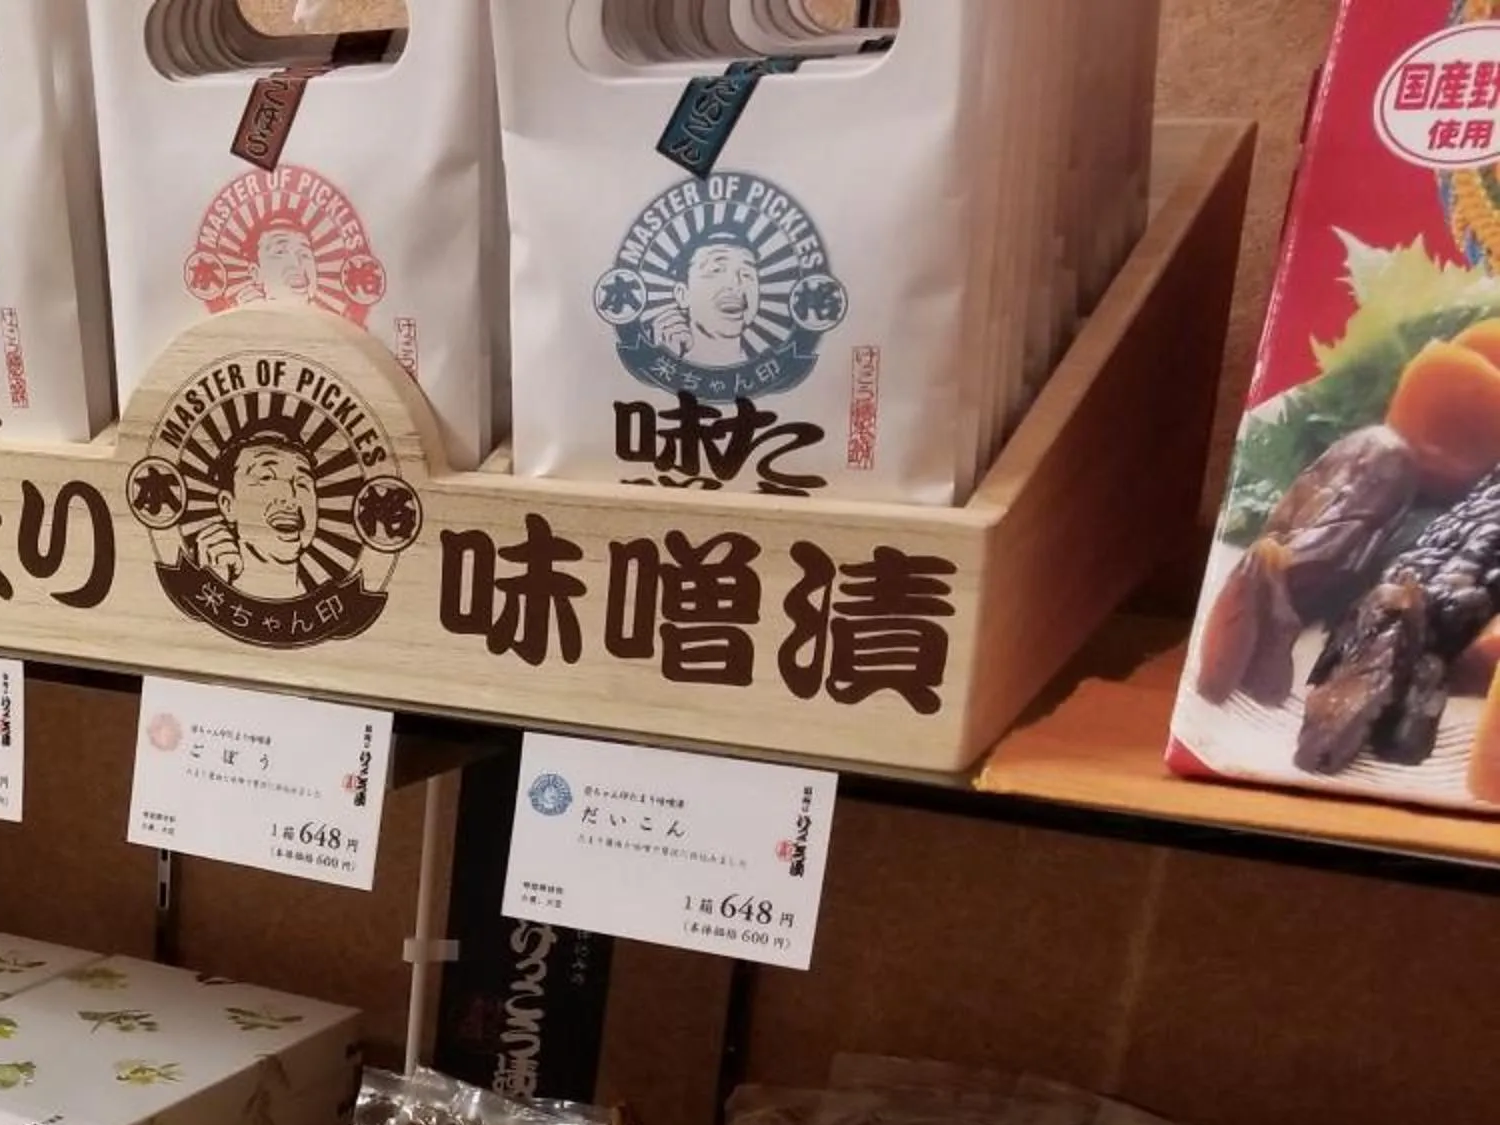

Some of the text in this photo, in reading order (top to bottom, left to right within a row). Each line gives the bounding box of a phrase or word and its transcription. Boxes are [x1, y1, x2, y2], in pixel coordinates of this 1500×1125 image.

[1428, 119, 1493, 151] 使用
[198, 169, 364, 251] MASTER OF PICKLES
[622, 176, 823, 269] MASTER OF PICKLES
[159, 358, 387, 467] MASTER OF PICKLES
[438, 513, 958, 716] 味噌漬
[190, 744, 270, 771] ごぼう
[581, 806, 686, 839] だいこん
